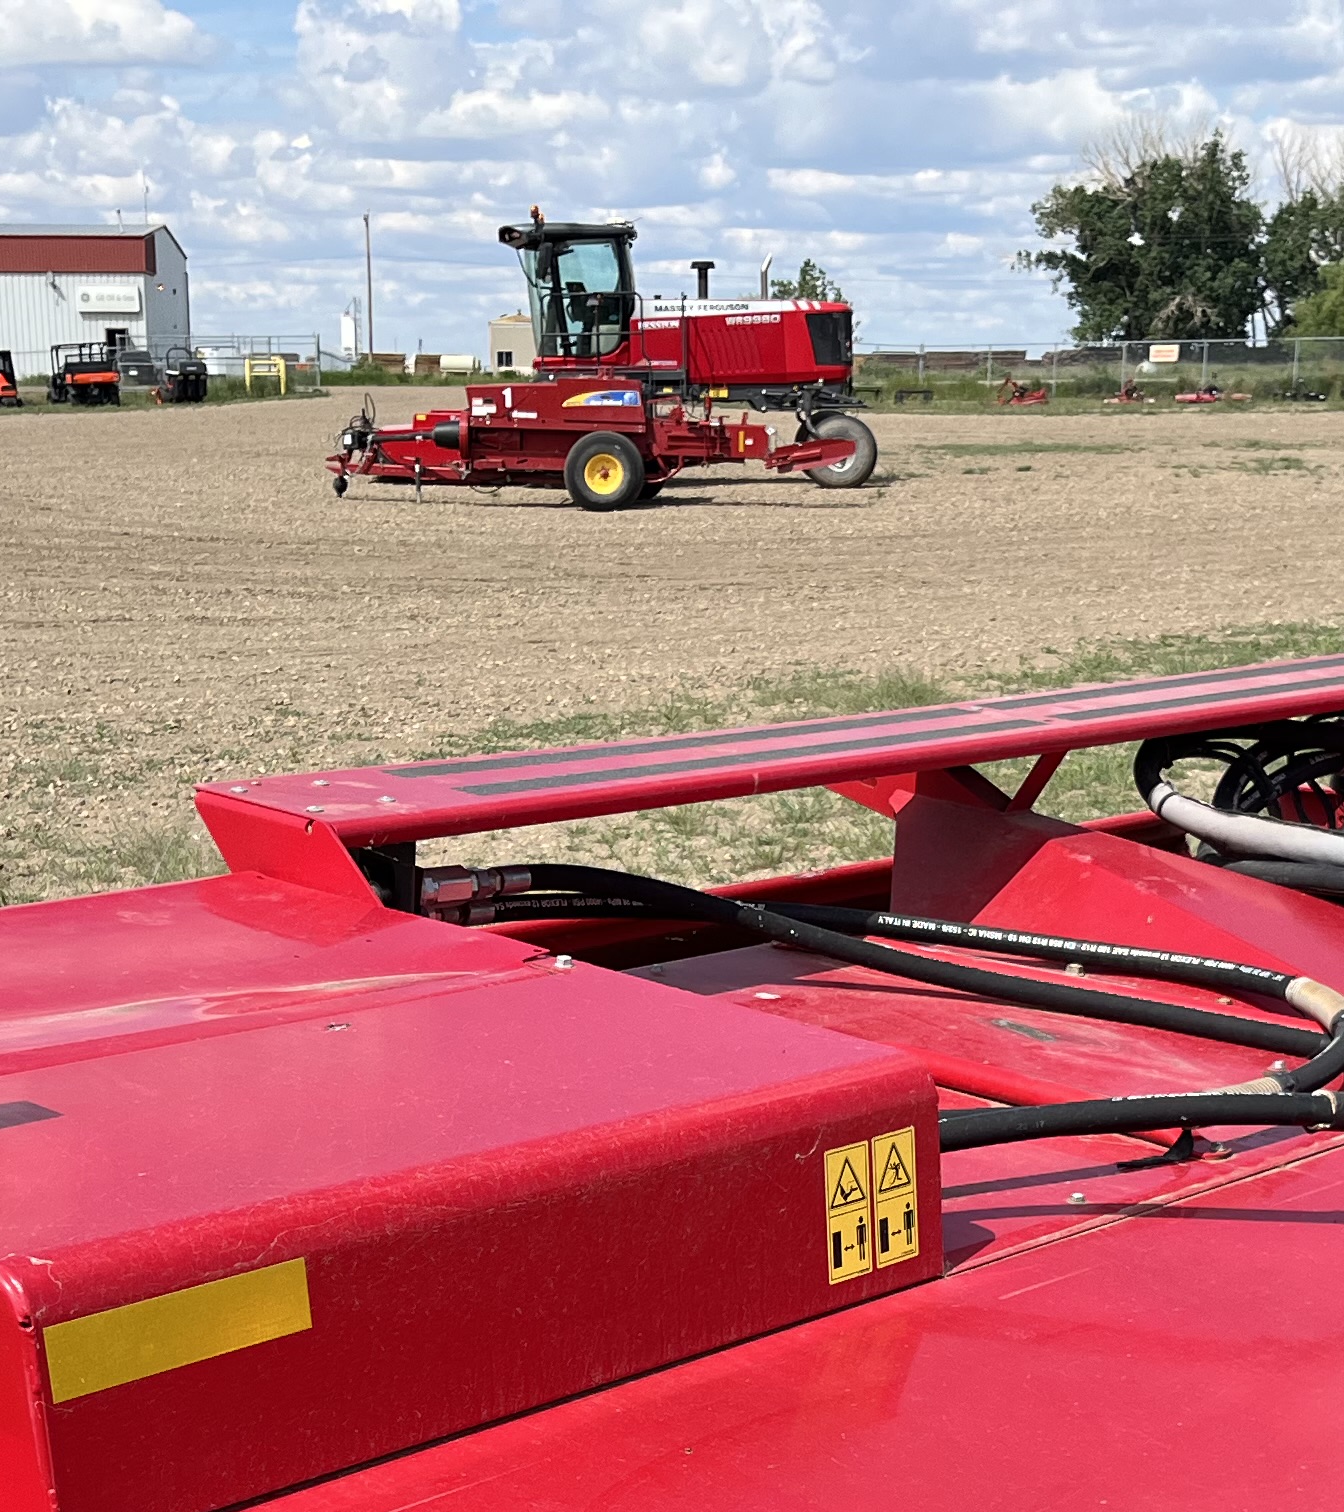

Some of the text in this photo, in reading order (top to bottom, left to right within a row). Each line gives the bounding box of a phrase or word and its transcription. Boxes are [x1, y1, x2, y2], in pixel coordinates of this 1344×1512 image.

[697, 303, 749, 312] FERGUSON
[501, 387, 513, 409] 1
[878, 915, 901, 926] ITALY
[902, 919, 911, 928] IN
[912, 920, 936, 931] MADE
